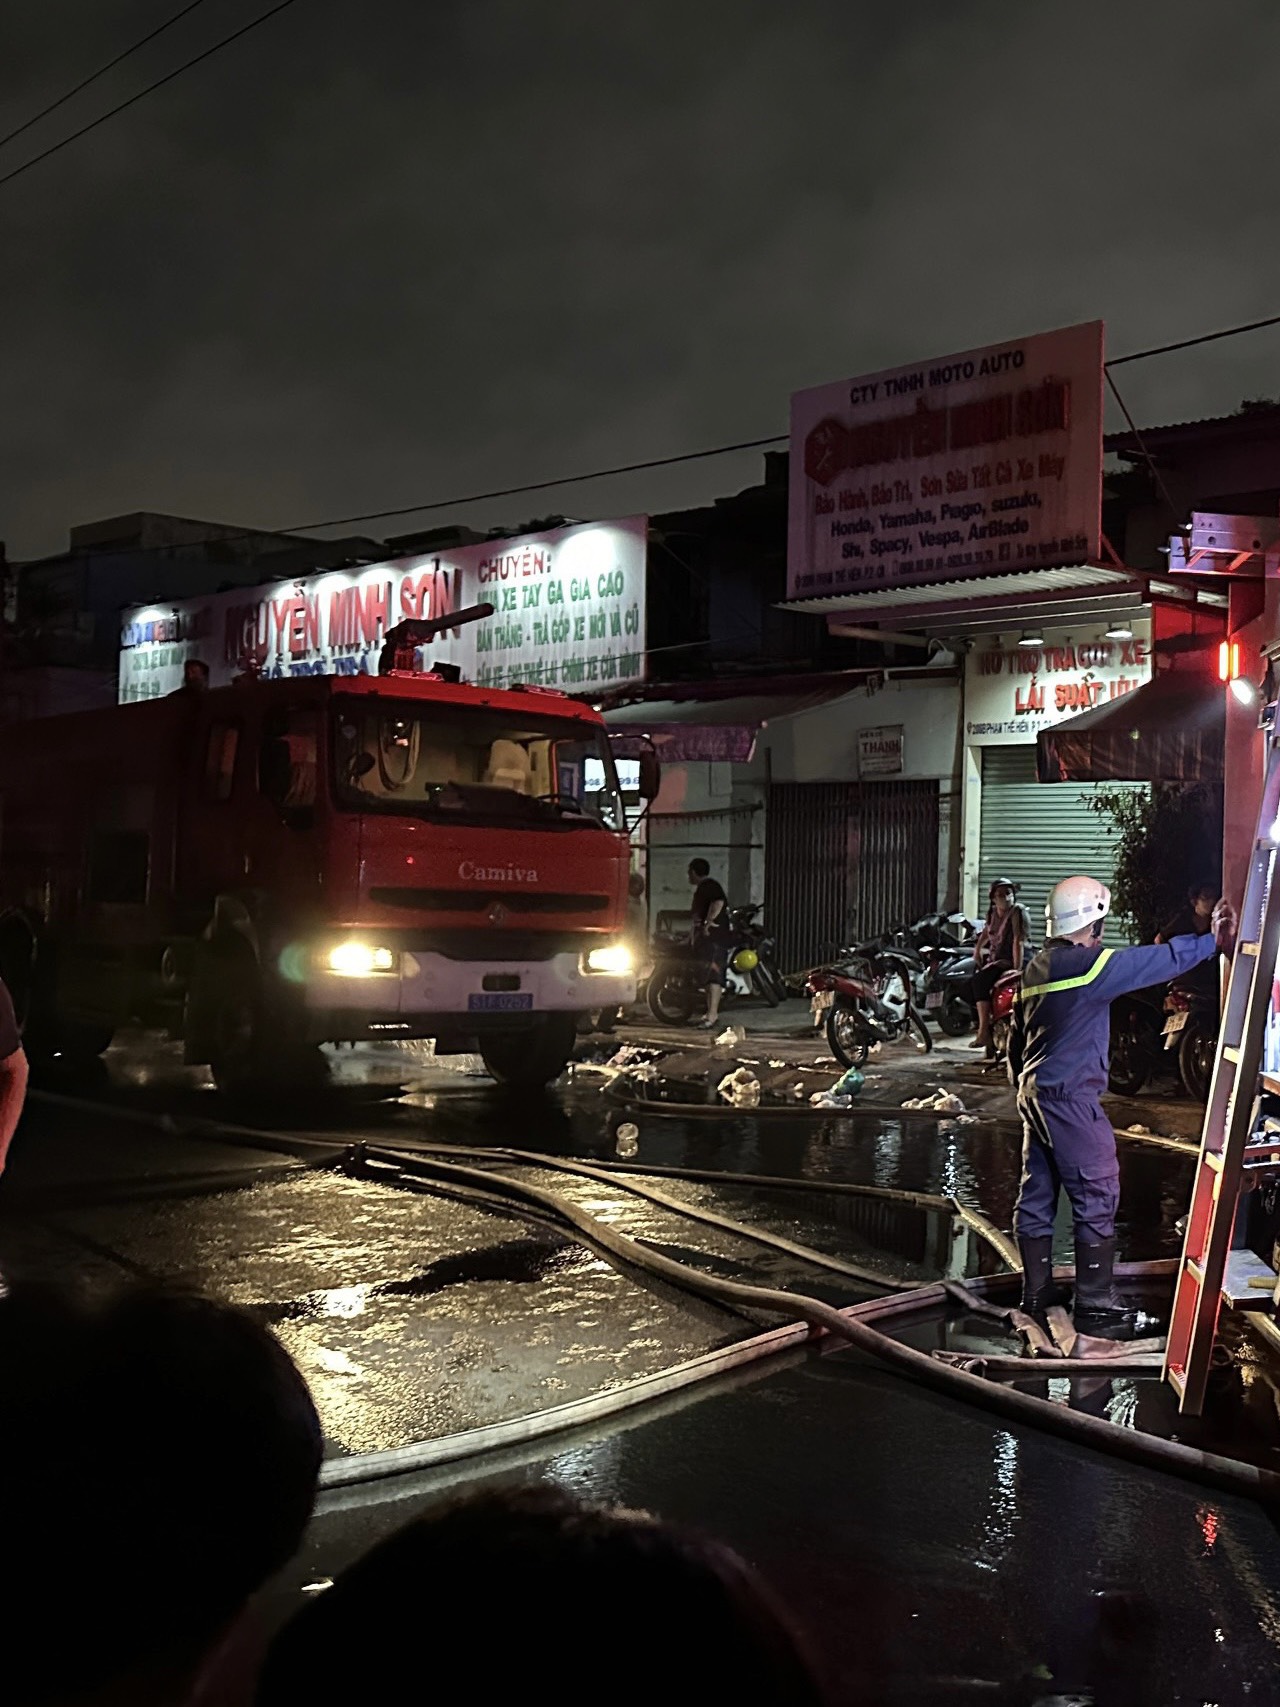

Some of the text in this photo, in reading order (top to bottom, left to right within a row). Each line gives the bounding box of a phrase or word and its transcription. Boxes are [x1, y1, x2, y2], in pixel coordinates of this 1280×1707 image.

[850, 350, 1025, 405] CTY TNHH MOTO AUTO
[831, 516, 875, 538] Honda,
[879, 507, 937, 531] Yamaha,
[869, 536, 912, 557] Spacy,
[918, 529, 965, 549] Vespa,
[328, 581, 394, 653] MINH
[400, 558, 464, 640] SƠN
[501, 586, 517, 612] XE
[522, 582, 543, 609] TAY
[547, 578, 565, 605] GA
[597, 570, 625, 598] CAO
[573, 616, 585, 641] XE
[1119, 639, 1147, 667] XE
[458, 860, 539, 883] Camiva
